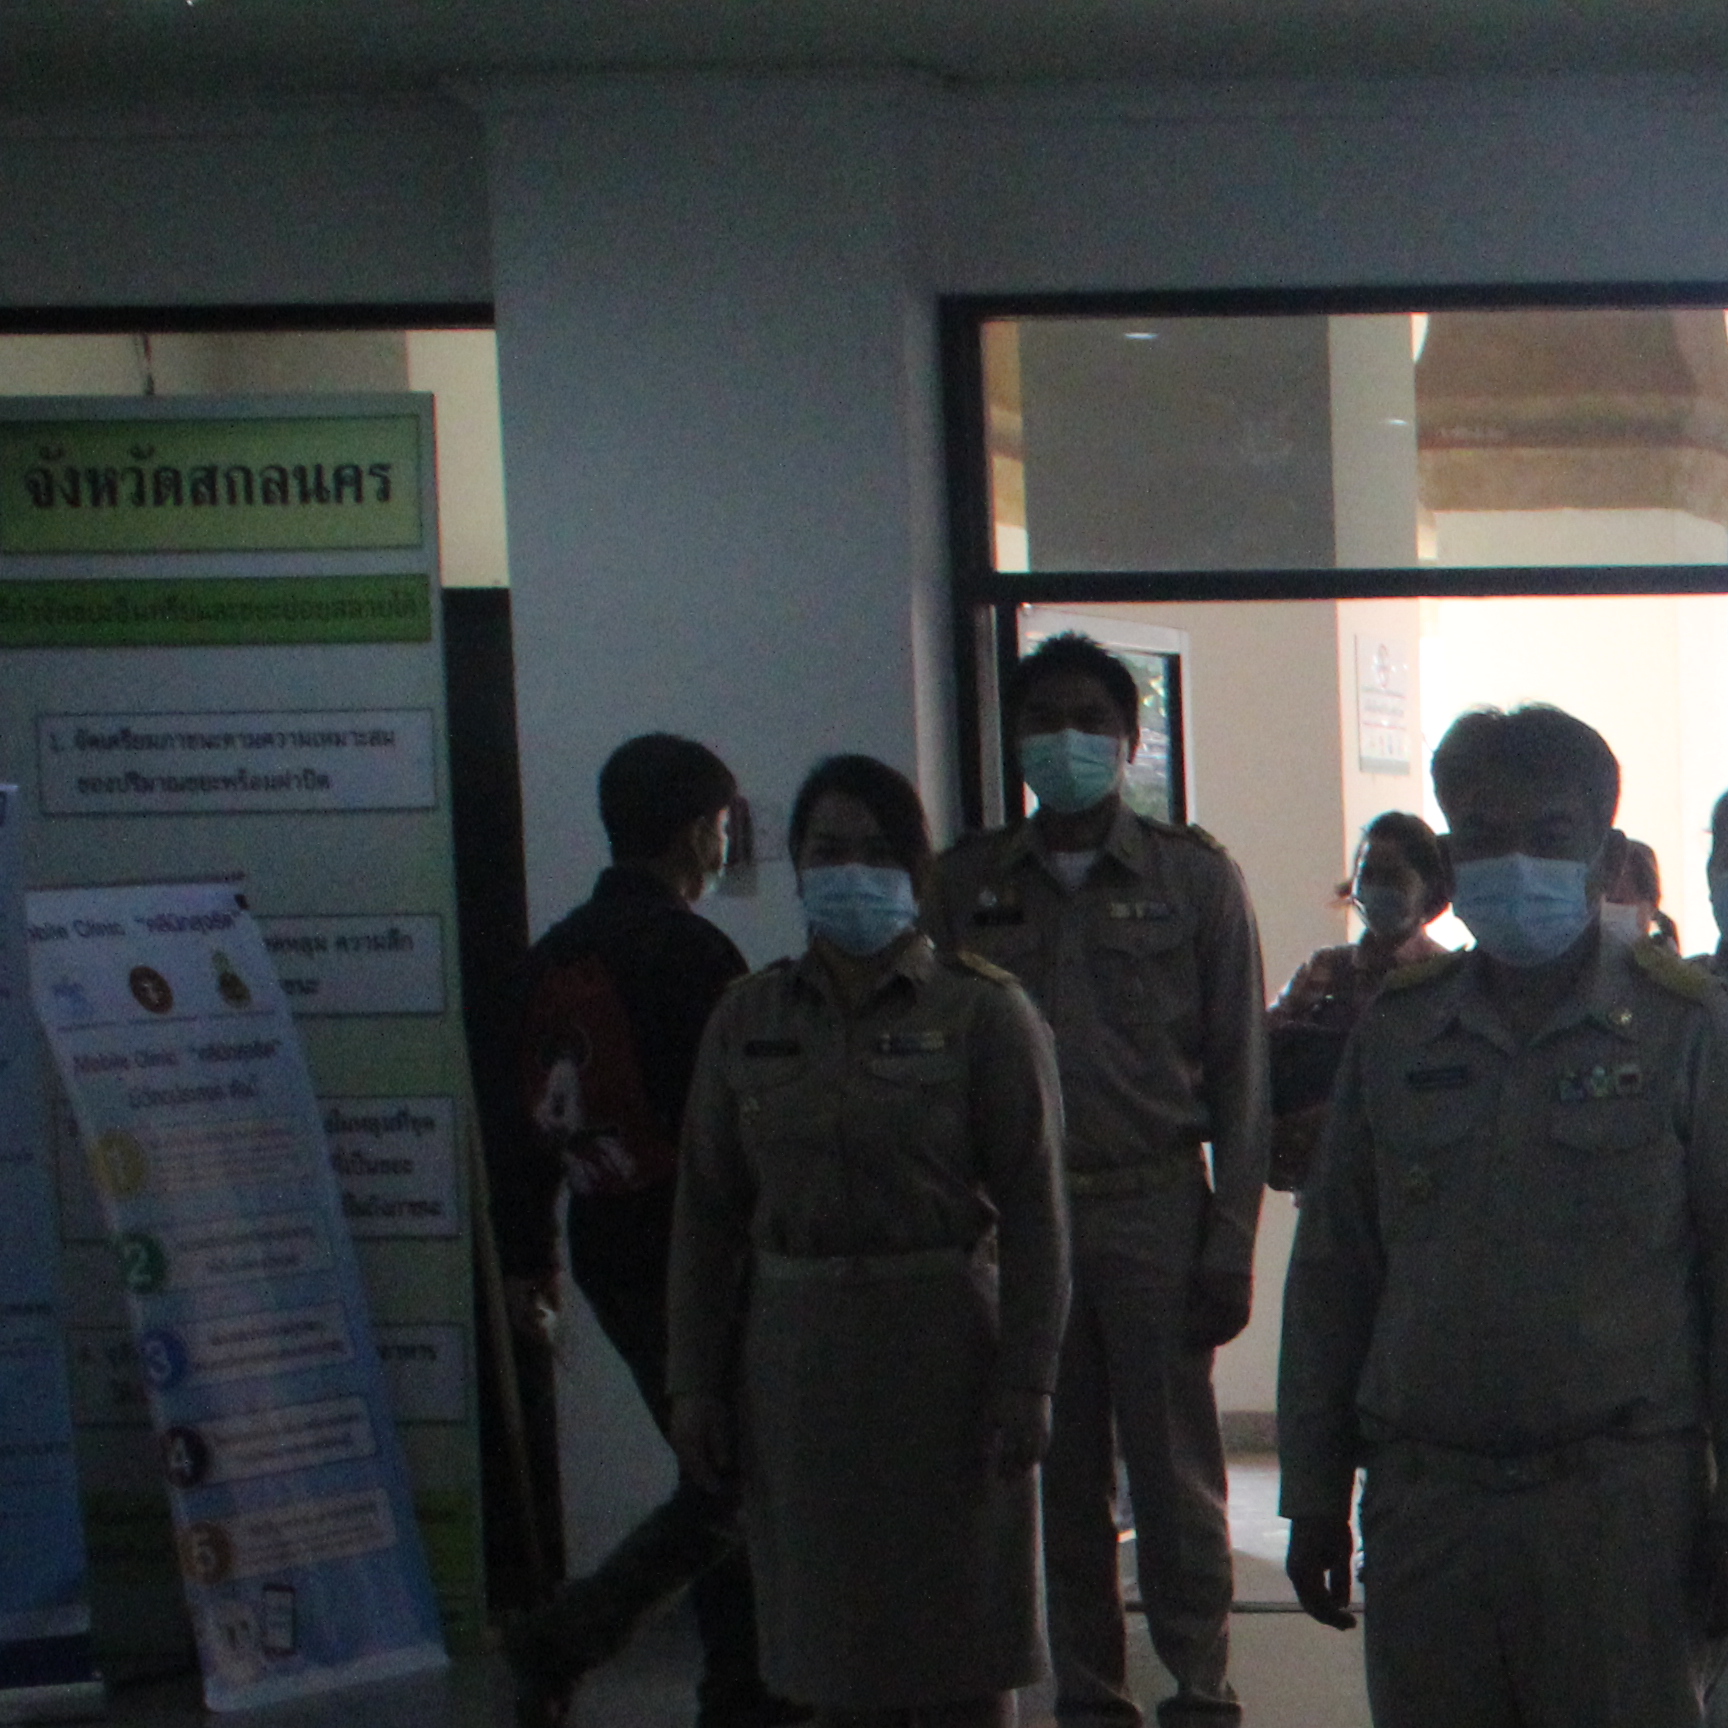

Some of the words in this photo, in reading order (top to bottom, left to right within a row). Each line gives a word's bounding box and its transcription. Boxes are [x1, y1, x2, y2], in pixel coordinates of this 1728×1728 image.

[23, 445, 393, 509] จังหวัดสกลนคร
[122, 1241, 151, 1287] 2
[145, 1340, 173, 1382] 3
[166, 1438, 192, 1475] 4
